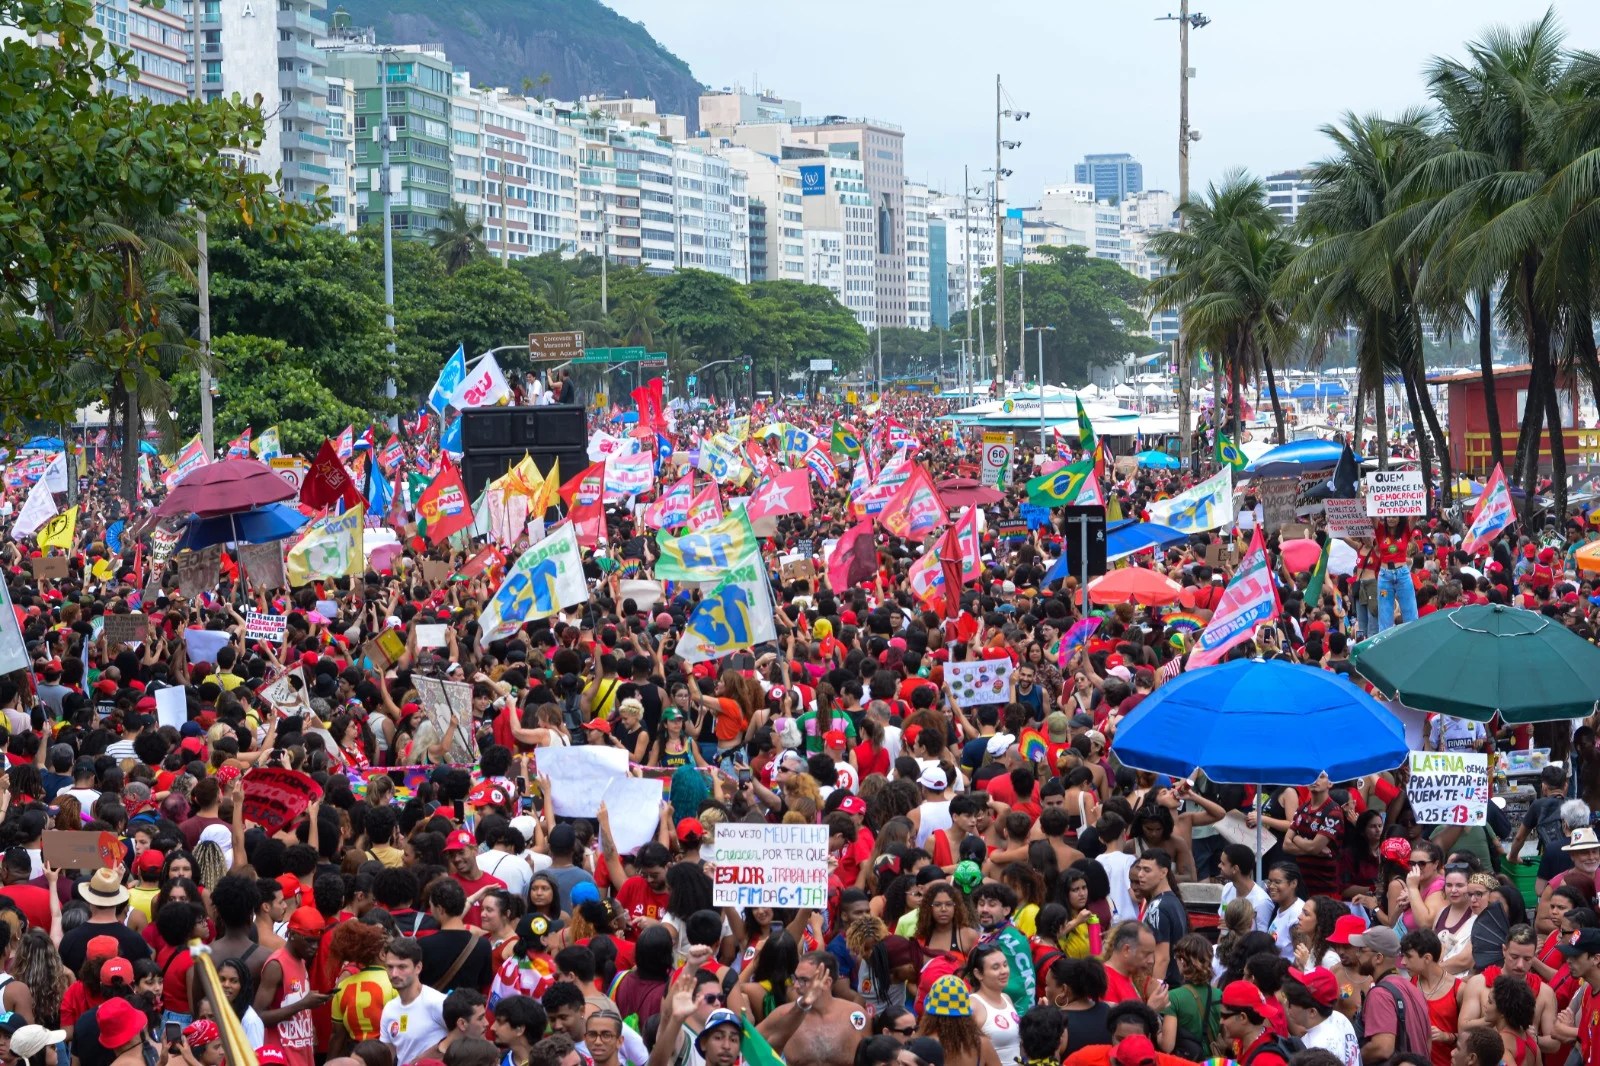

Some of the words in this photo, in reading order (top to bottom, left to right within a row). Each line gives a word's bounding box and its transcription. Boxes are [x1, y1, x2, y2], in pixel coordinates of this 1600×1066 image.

[1015, 402, 1041, 410] PagBank
[785, 429, 809, 452] 13
[992, 449, 1005, 459] 60
[1376, 474, 1405, 482] QUEM
[1370, 484, 1411, 494] ADORMECE
[769, 492, 782, 502] PT
[1374, 493, 1425, 502] DEMOCRACIA
[1377, 506, 1422, 514] DITADURA
[1447, 739, 1473, 748] RIVALO
[1412, 754, 1465, 774] LATINA
[1409, 775, 1434, 790] PRA
[1435, 774, 1473, 787] VOTAR
[1407, 789, 1440, 804] QUEM
[1443, 789, 1459, 800] TE
[1425, 808, 1439, 822] 25
[1442, 808, 1449, 822] É
[1452, 804, 1469, 824] 13
[717, 828, 736, 838] NÃO
[738, 829, 762, 839] VEJO
[764, 826, 789, 844] MEU
[790, 826, 828, 844] FILHO
[762, 848, 782, 860] POR
[784, 848, 804, 861] TER
[805, 848, 826, 862] QUE
[715, 866, 765, 885] ESTUDAR
[772, 867, 828, 884] TRABALHAR
[715, 889, 738, 902] PELO
[738, 887, 763, 905] FIM
[763, 889, 778, 902] DA
